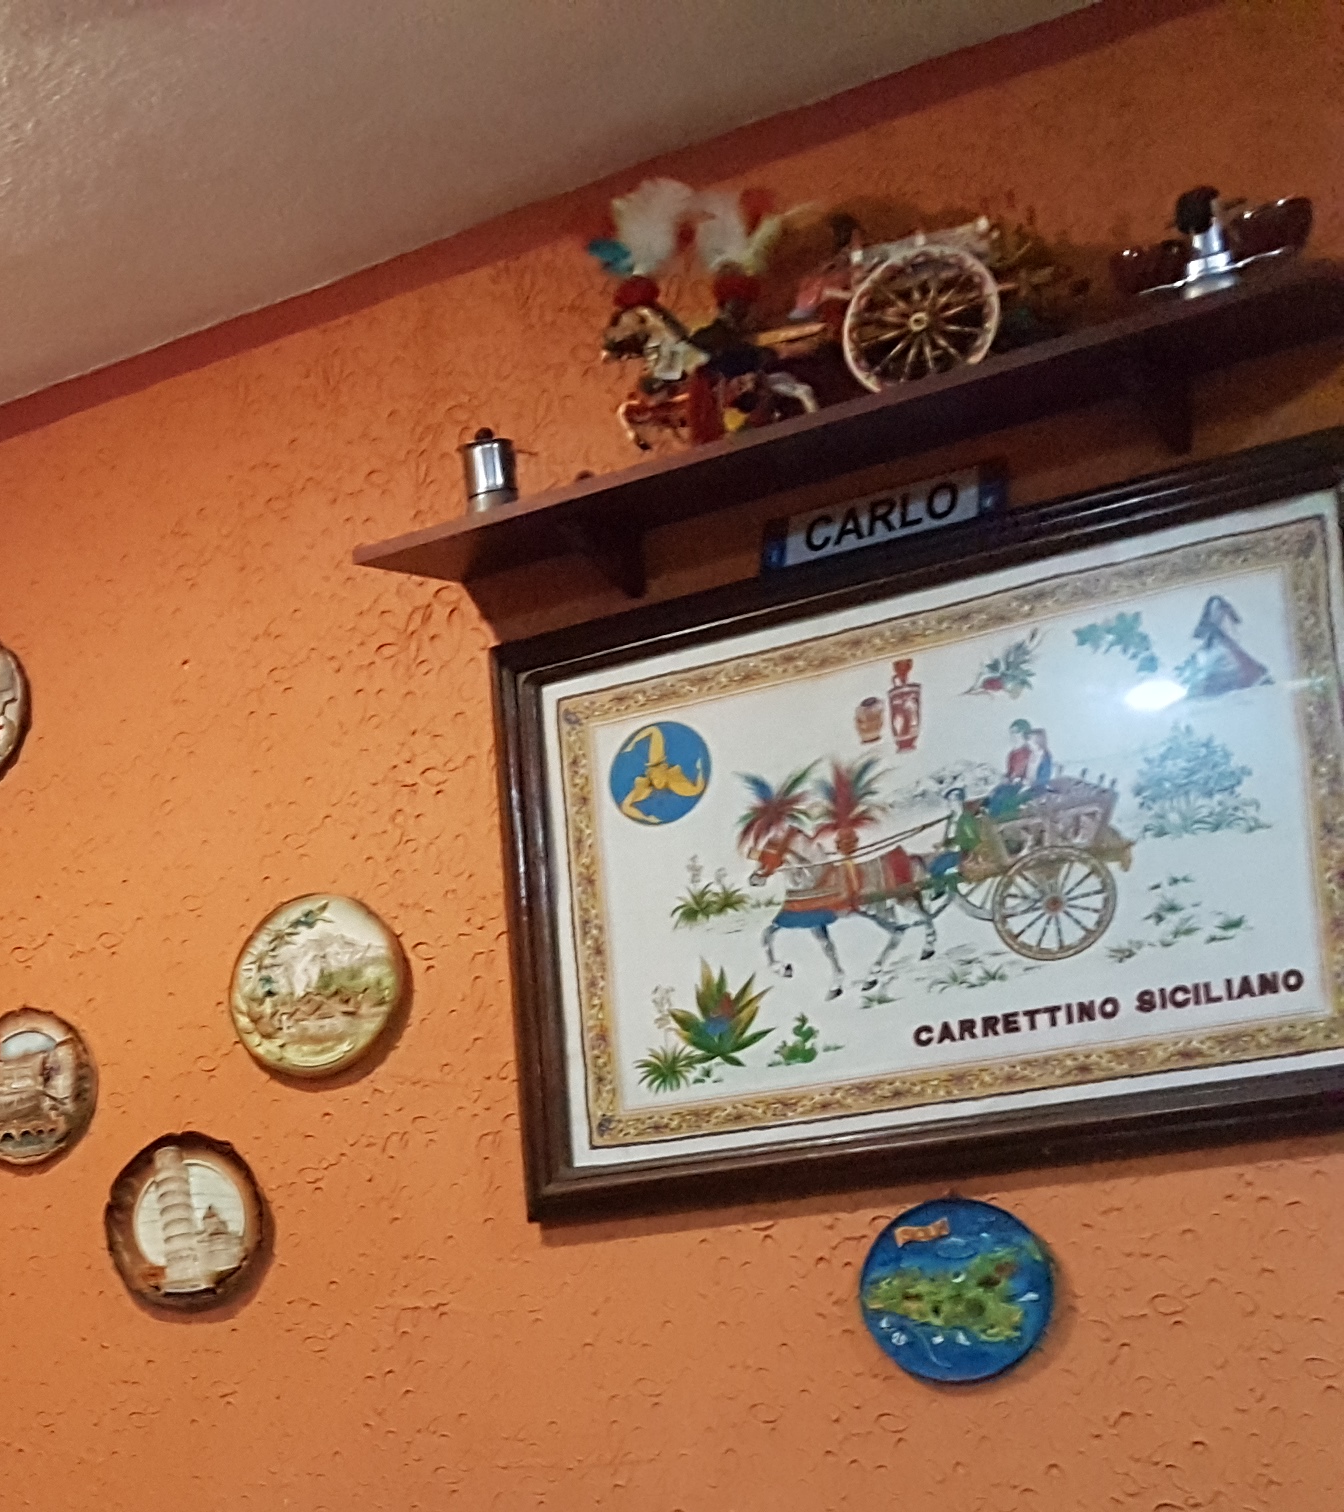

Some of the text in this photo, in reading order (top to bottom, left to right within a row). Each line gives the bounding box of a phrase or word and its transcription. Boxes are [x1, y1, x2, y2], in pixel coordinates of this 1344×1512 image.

[805, 482, 959, 551] CARLO
[912, 968, 1305, 1047] CARRETTINO SICILIANO
